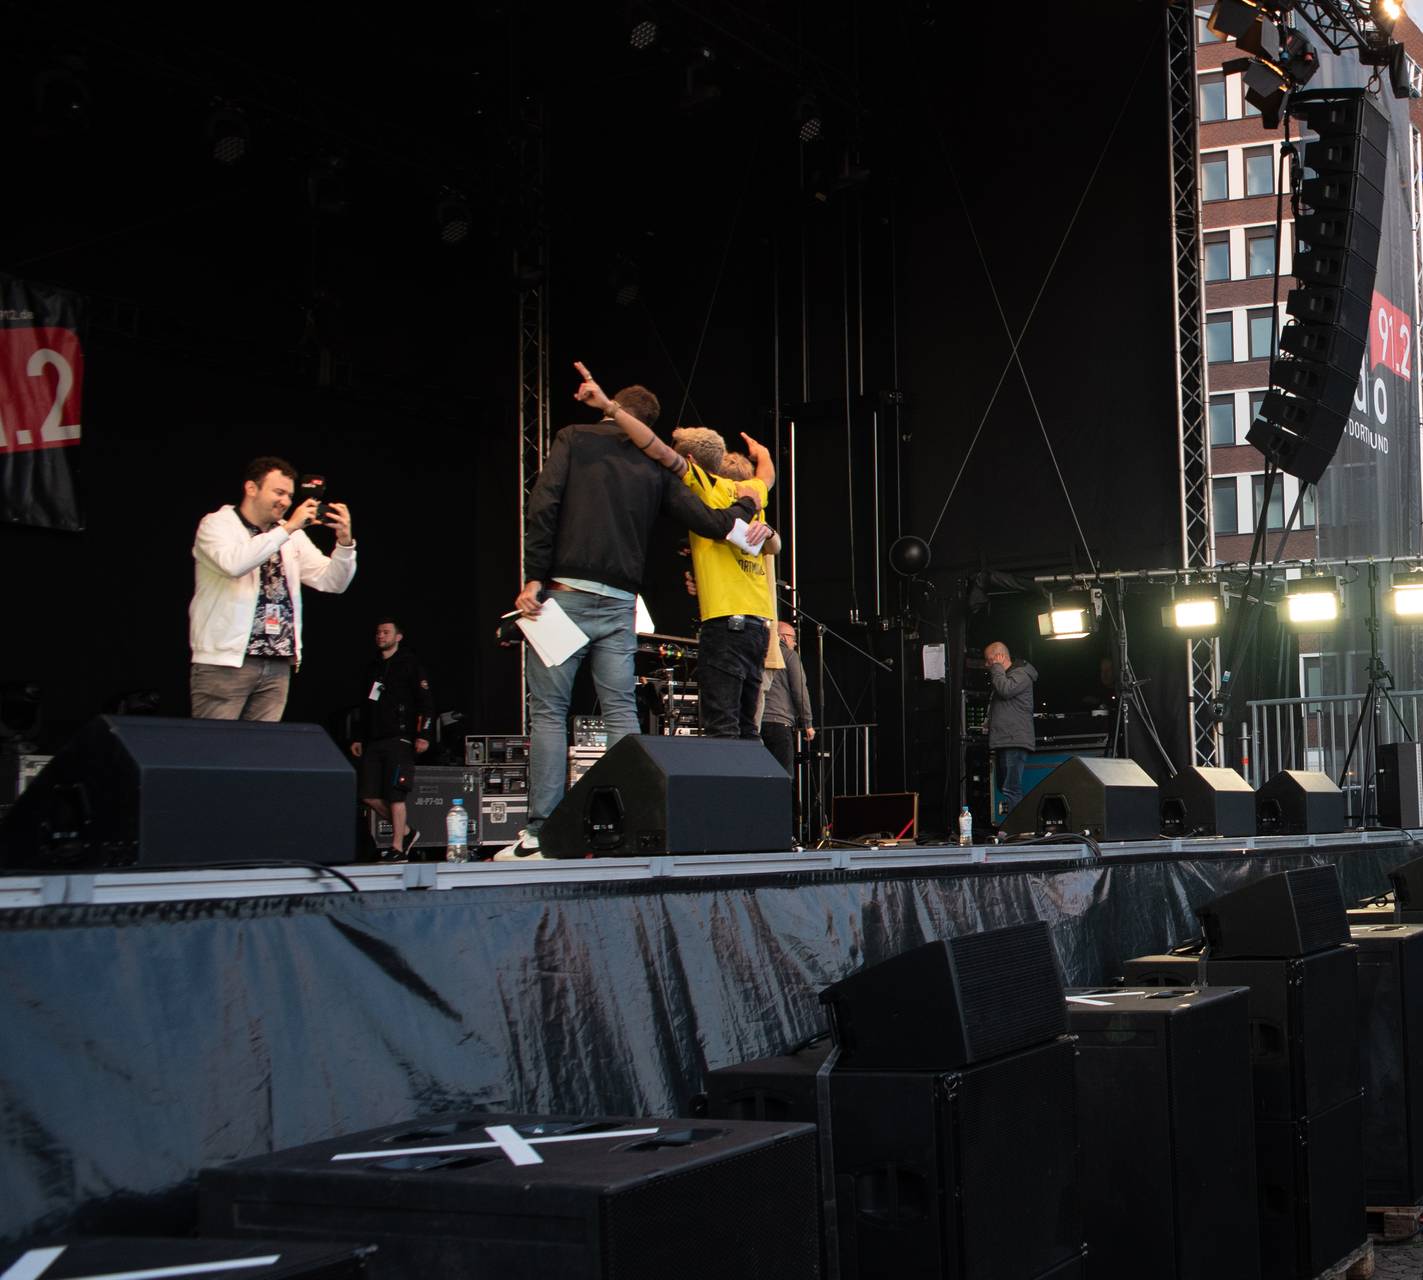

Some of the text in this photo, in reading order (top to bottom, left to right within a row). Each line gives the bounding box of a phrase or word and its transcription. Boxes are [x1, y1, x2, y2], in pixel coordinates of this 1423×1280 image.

[1378, 307, 1411, 379] 91.2
[0, 347, 81, 447] .2
[1348, 418, 1389, 455] DORTUND
